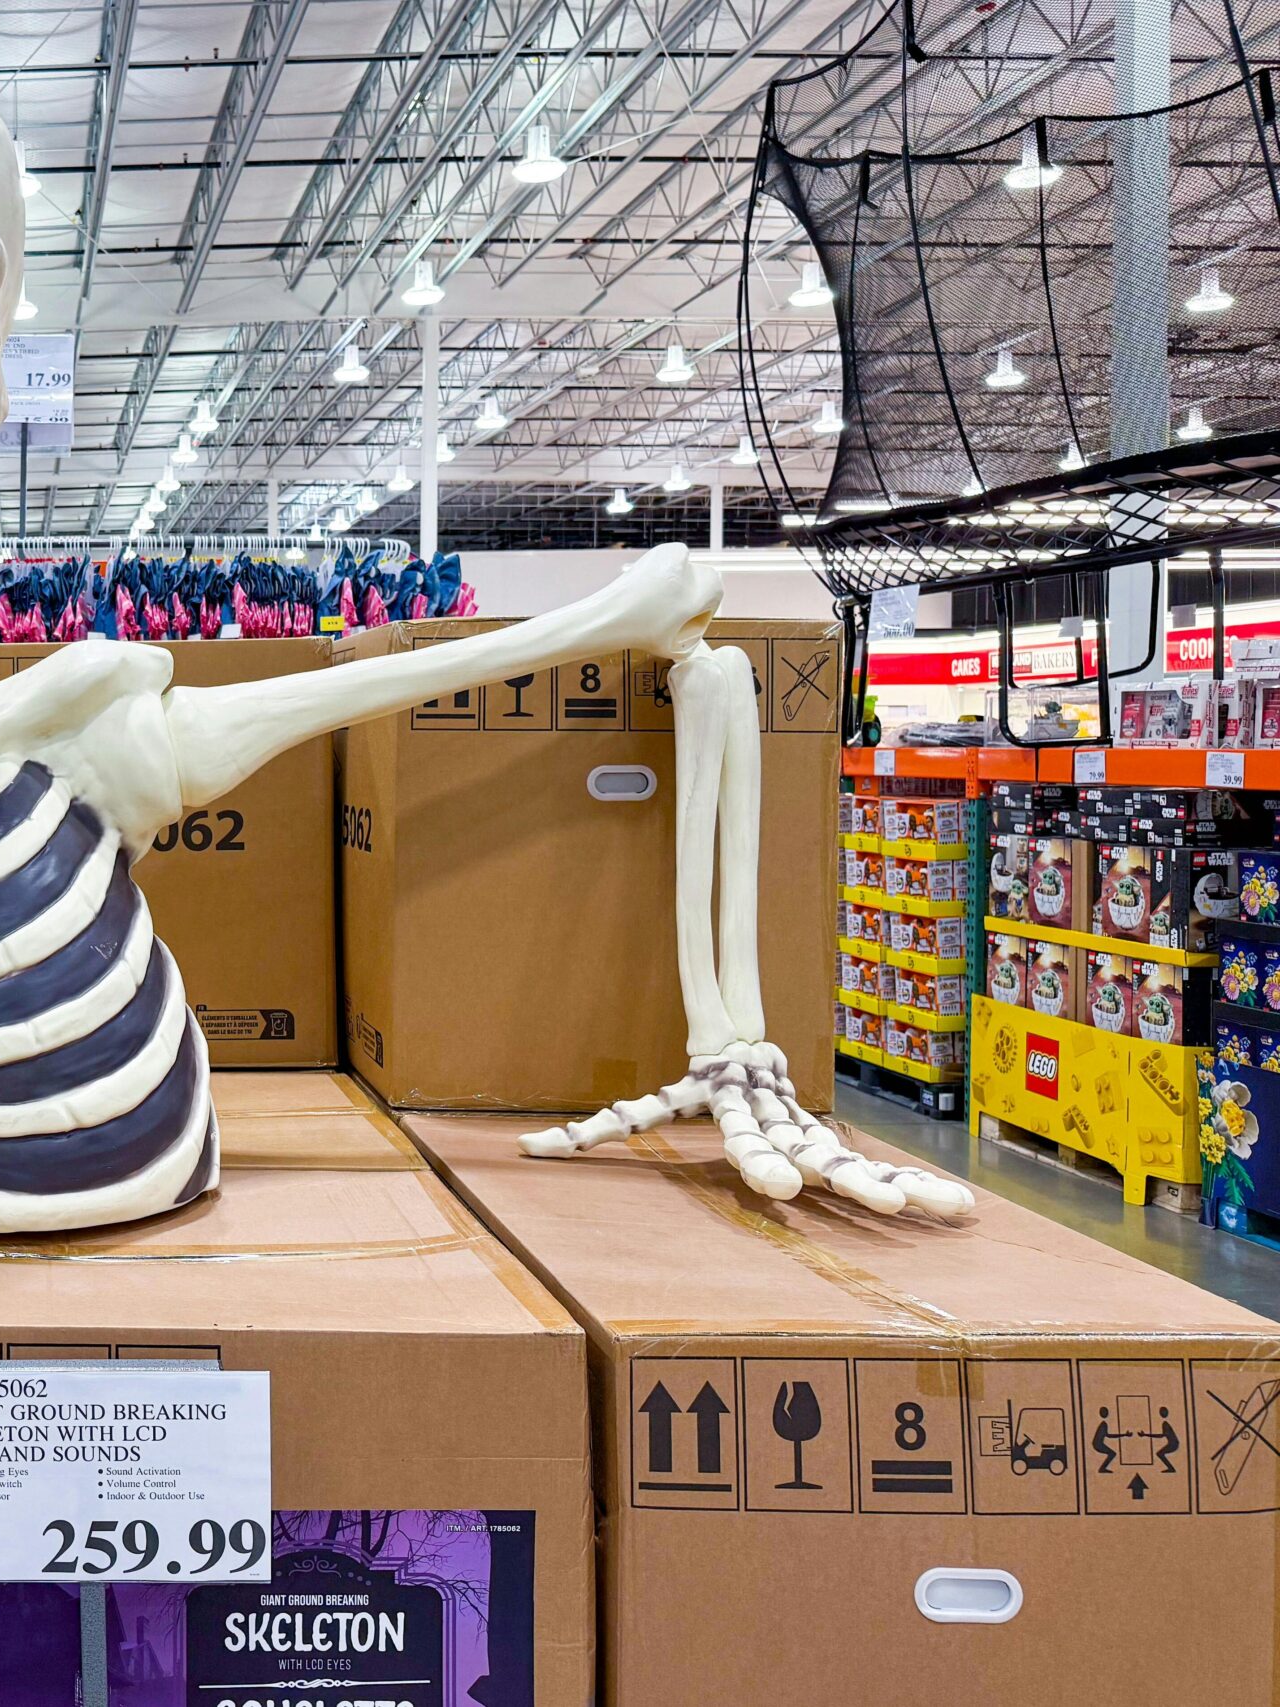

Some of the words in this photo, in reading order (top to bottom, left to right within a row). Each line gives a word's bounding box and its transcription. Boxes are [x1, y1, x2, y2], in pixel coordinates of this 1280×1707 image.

[26, 373, 71, 387] 17.99
[951, 657, 981, 677] CAKES
[1033, 651, 1075, 670] BAKERY
[580, 663, 601, 693] 8
[1089, 771, 1105, 781] 79.99
[1223, 774, 1243, 785] 39.99
[1210, 852, 1234, 860] STAR
[1027, 1049, 1058, 1082] LEGO
[10, 1404, 105, 1421] GROUND
[113, 1404, 226, 1421] BREAKING
[57, 1425, 115, 1442] WITH
[122, 1425, 167, 1442] LCD
[895, 1402, 926, 1450] 8
[52, 1445, 141, 1462] SOUNDS
[8, 1468, 29, 1477] Eyes
[106, 1467, 133, 1476] Sound
[136, 1467, 181, 1476] Activation
[106, 1480, 140, 1488] Volume
[143, 1480, 176, 1488] Control
[106, 1492, 135, 1500] Indoor
[138, 1492, 146, 1500] &
[149, 1492, 185, 1500] Outdoor
[188, 1492, 205, 1500] Use
[41, 1518, 266, 1575] 259.99
[260, 1594, 286, 1606] GIANT
[288, 1594, 324, 1606] GROUND
[325, 1594, 369, 1606] BREAKING
[224, 1612, 405, 1652] SKELETON
[278, 1659, 303, 1670] WITH
[305, 1659, 324, 1670] LCD
[327, 1659, 352, 1670] EYES
